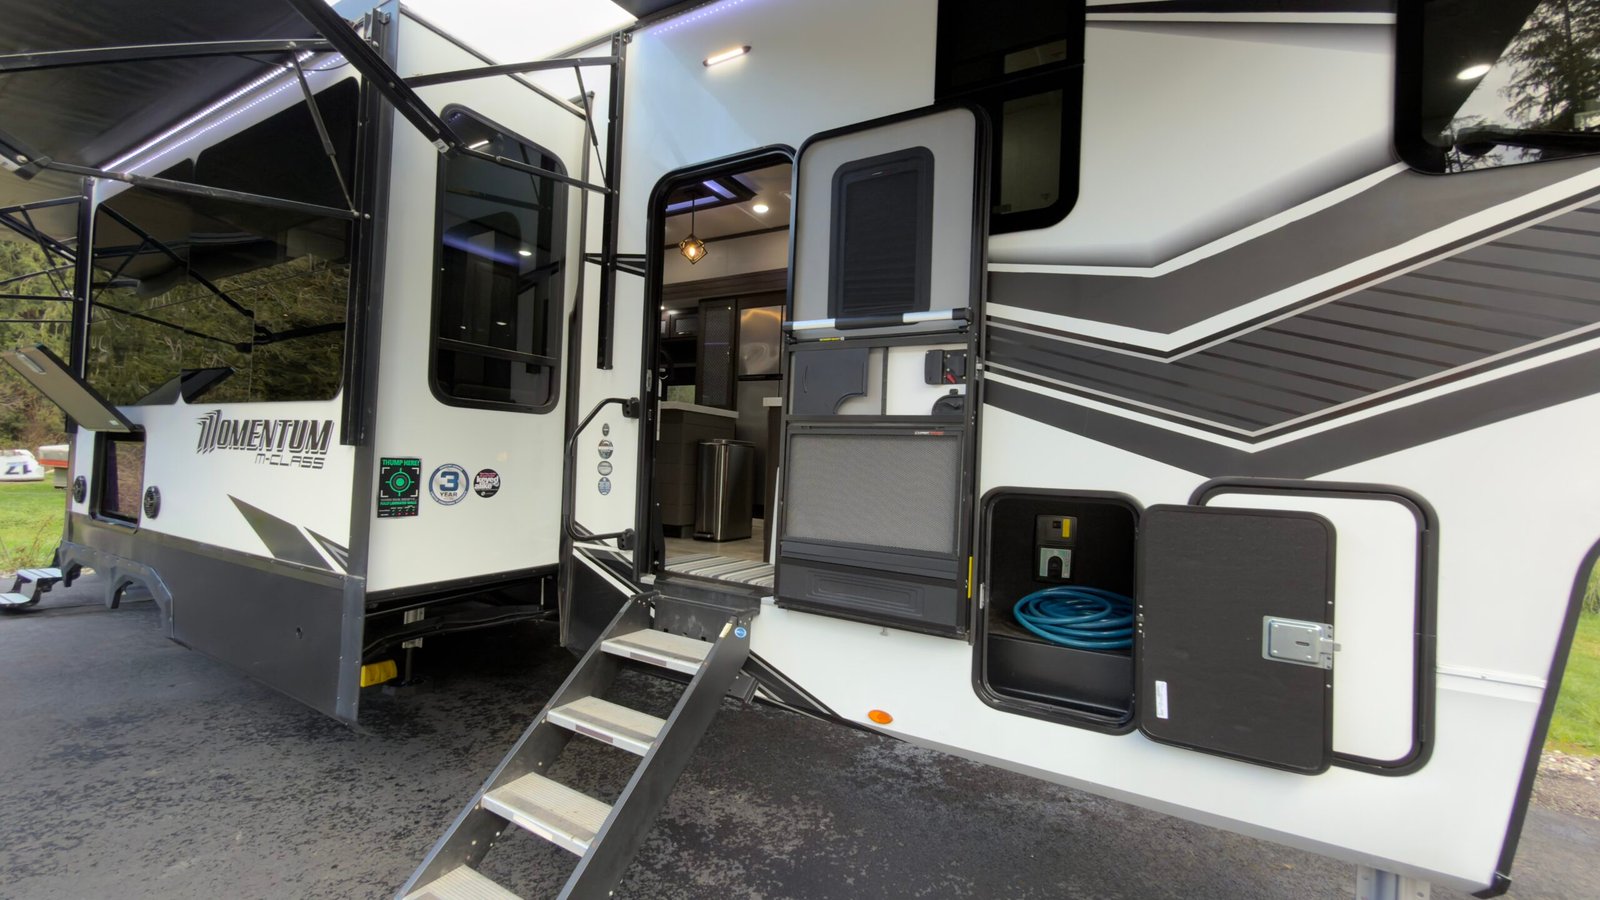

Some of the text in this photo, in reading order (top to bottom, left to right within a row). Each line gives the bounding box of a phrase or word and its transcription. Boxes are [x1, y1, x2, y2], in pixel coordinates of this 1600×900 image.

[196, 409, 334, 455] MOMENTUM
[255, 453, 325, 469] M-CLASS
[440, 471, 459, 491] 3
